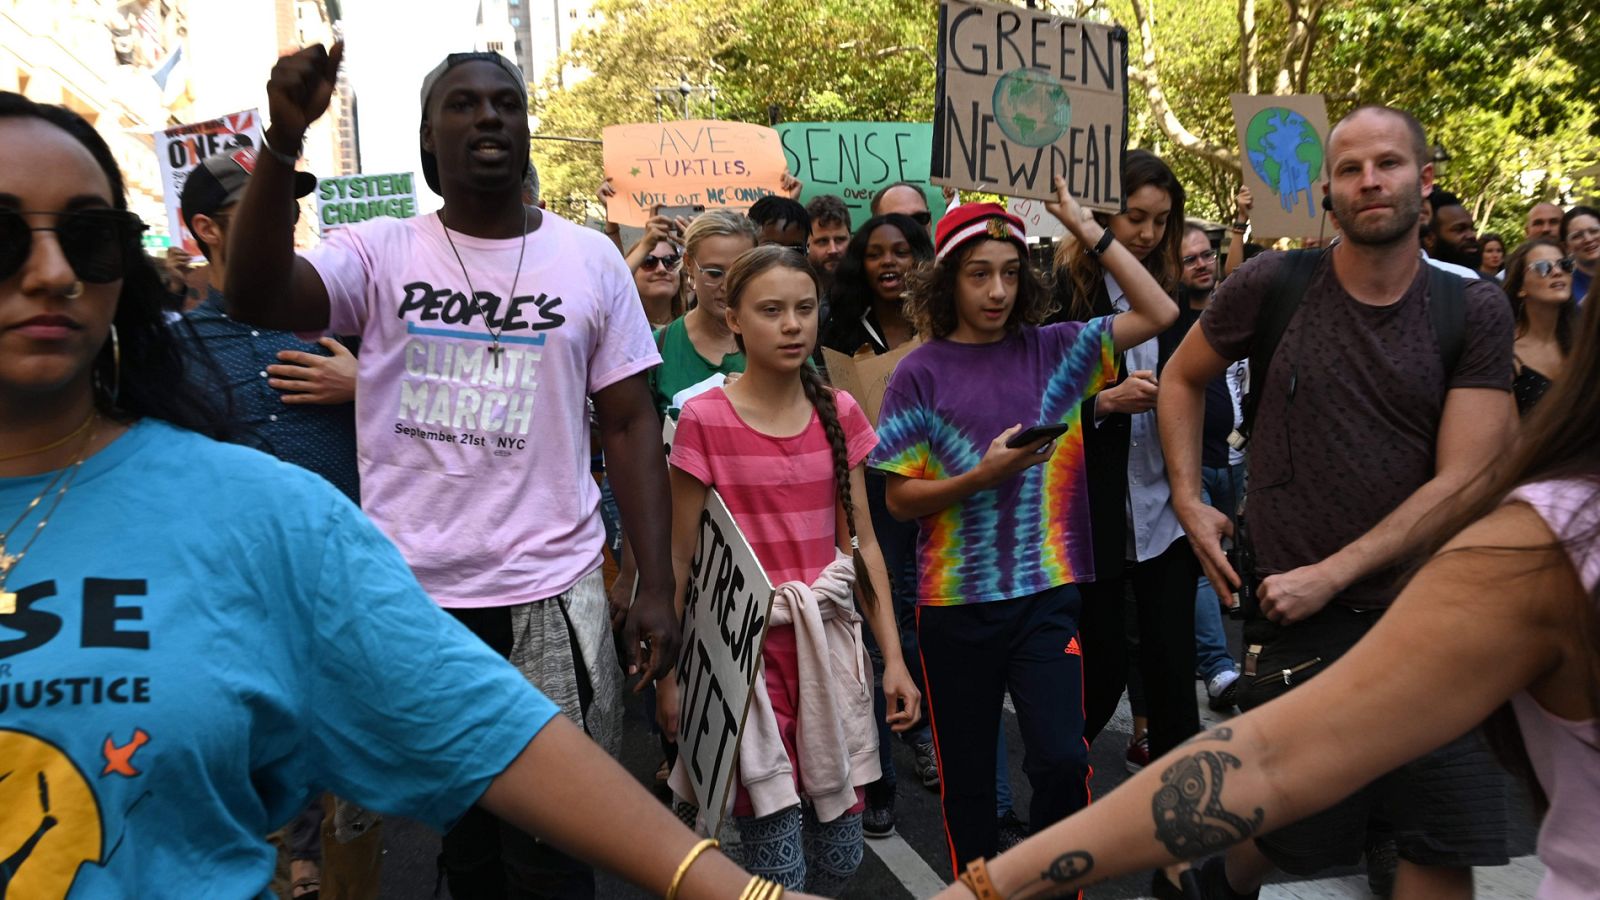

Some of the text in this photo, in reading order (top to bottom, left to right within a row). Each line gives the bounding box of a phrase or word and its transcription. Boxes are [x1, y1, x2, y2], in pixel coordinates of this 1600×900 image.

[950, 6, 1114, 90] GREEN
[168, 133, 222, 169] ONE
[623, 126, 735, 157] SAVE
[781, 127, 926, 185] SENSE
[945, 96, 1119, 204] NEW DEAL
[636, 157, 752, 178] TURTLES,
[320, 173, 412, 200] SYSTEM
[632, 191, 667, 207] VOTE
[675, 192, 701, 206] OUT
[843, 187, 876, 200] over
[322, 197, 416, 225] CHANGE
[398, 281, 566, 331] PEOPLE'S
[404, 338, 542, 391] CLIMATE
[398, 379, 535, 435] MARCH
[394, 423, 526, 450] September 21st NYC
[0, 577, 151, 660] SE
[0, 677, 151, 713] JUSTICE
[676, 608, 738, 811] ATET
